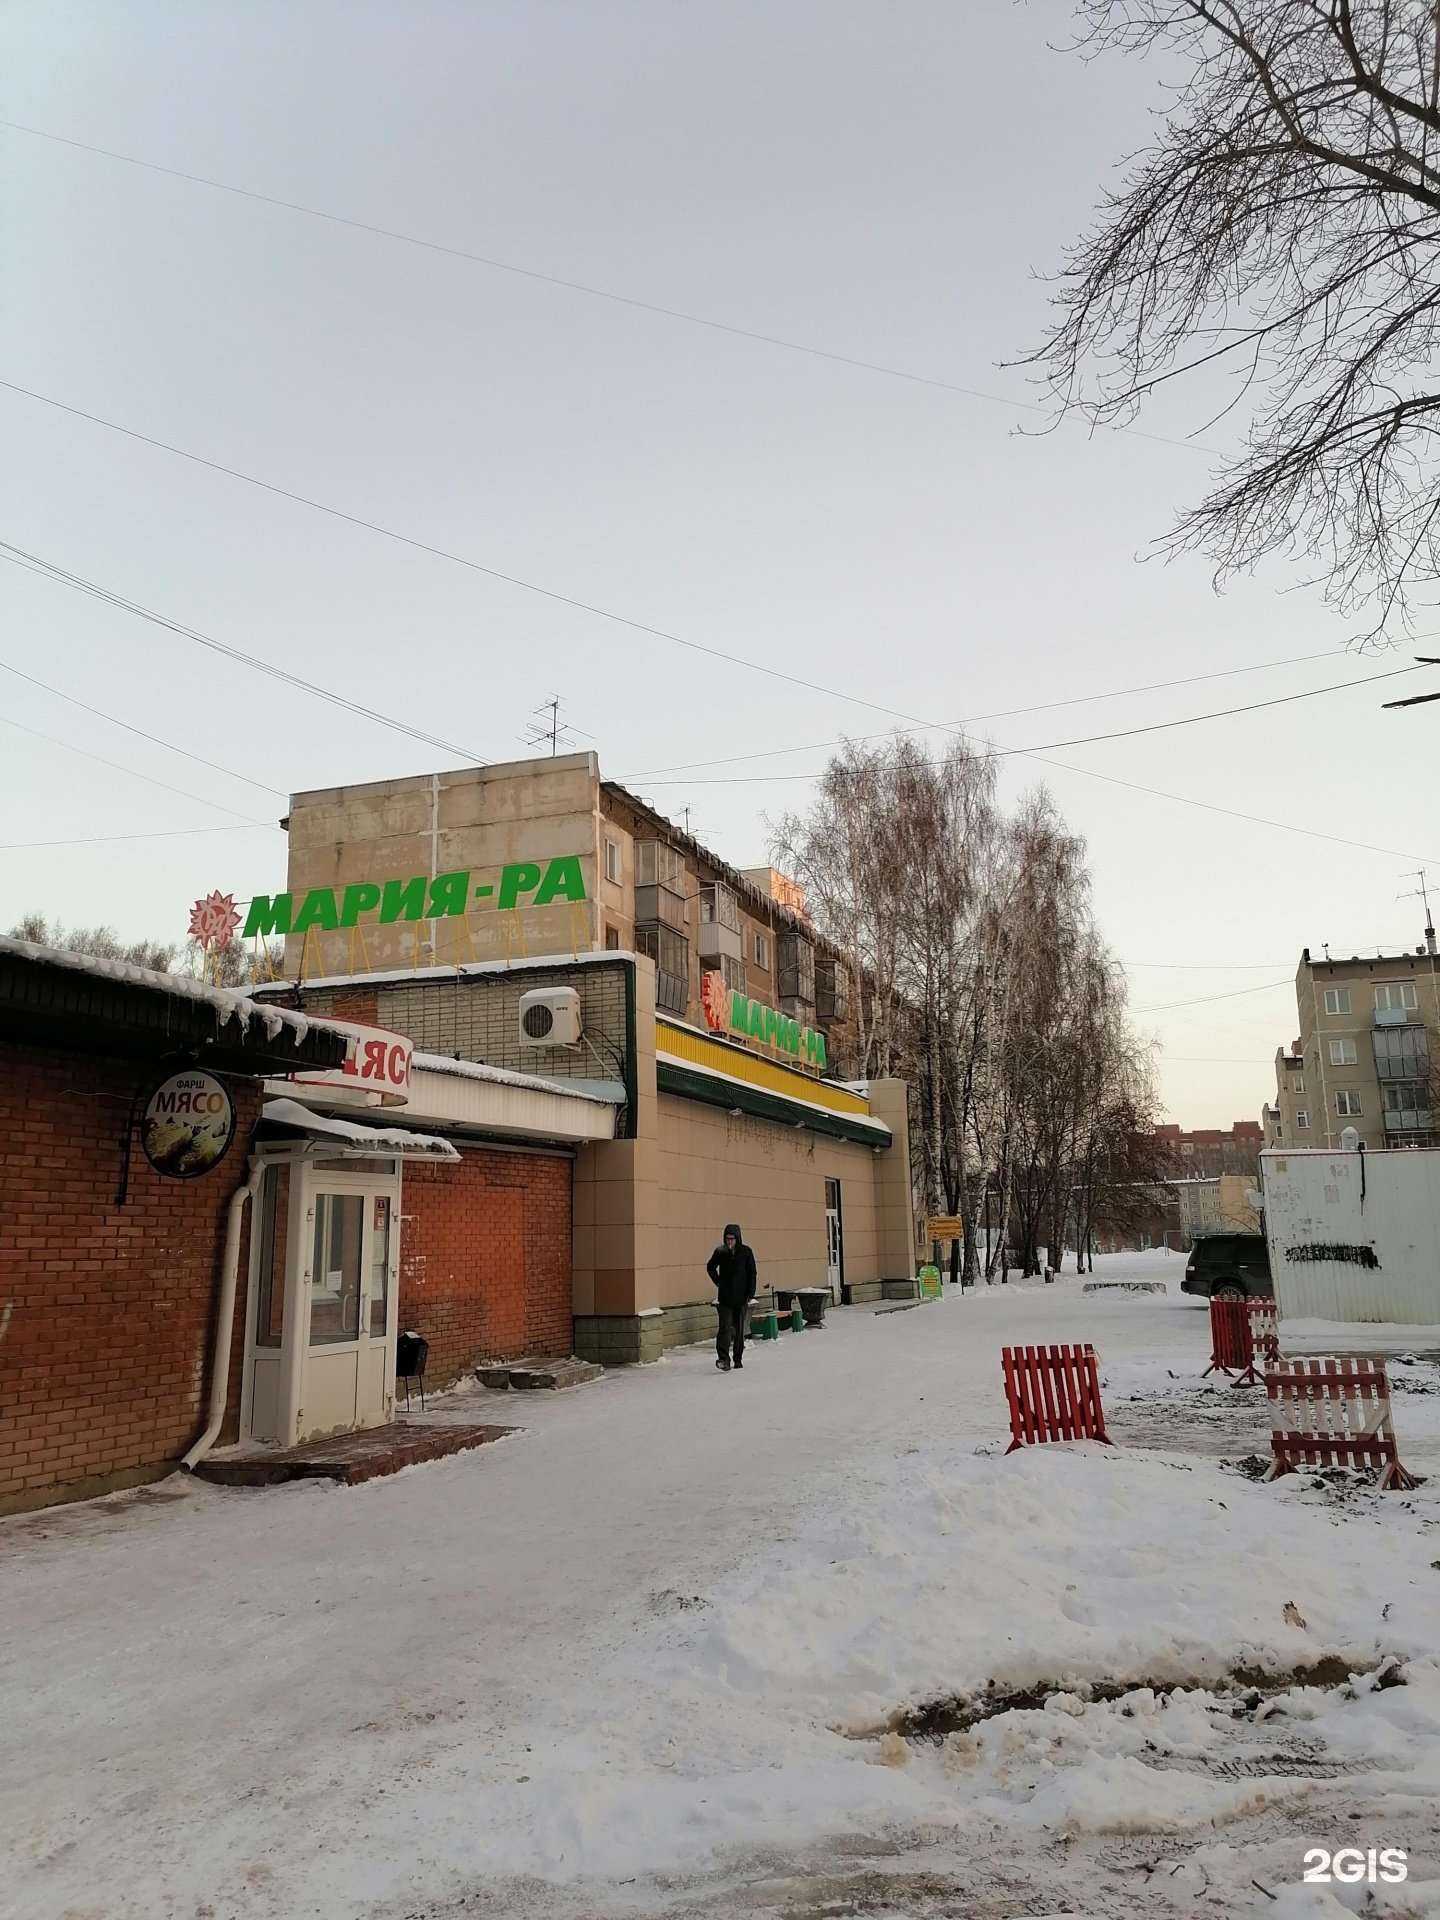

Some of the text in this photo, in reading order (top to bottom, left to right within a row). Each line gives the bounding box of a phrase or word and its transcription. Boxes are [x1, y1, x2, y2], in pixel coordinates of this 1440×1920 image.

[242, 855, 586, 938] МАРИЯ-РА
[341, 1038, 412, 1088] ЯС
[176, 1079, 205, 1089] ФАРШ
[155, 1092, 225, 1114] МЯСО
